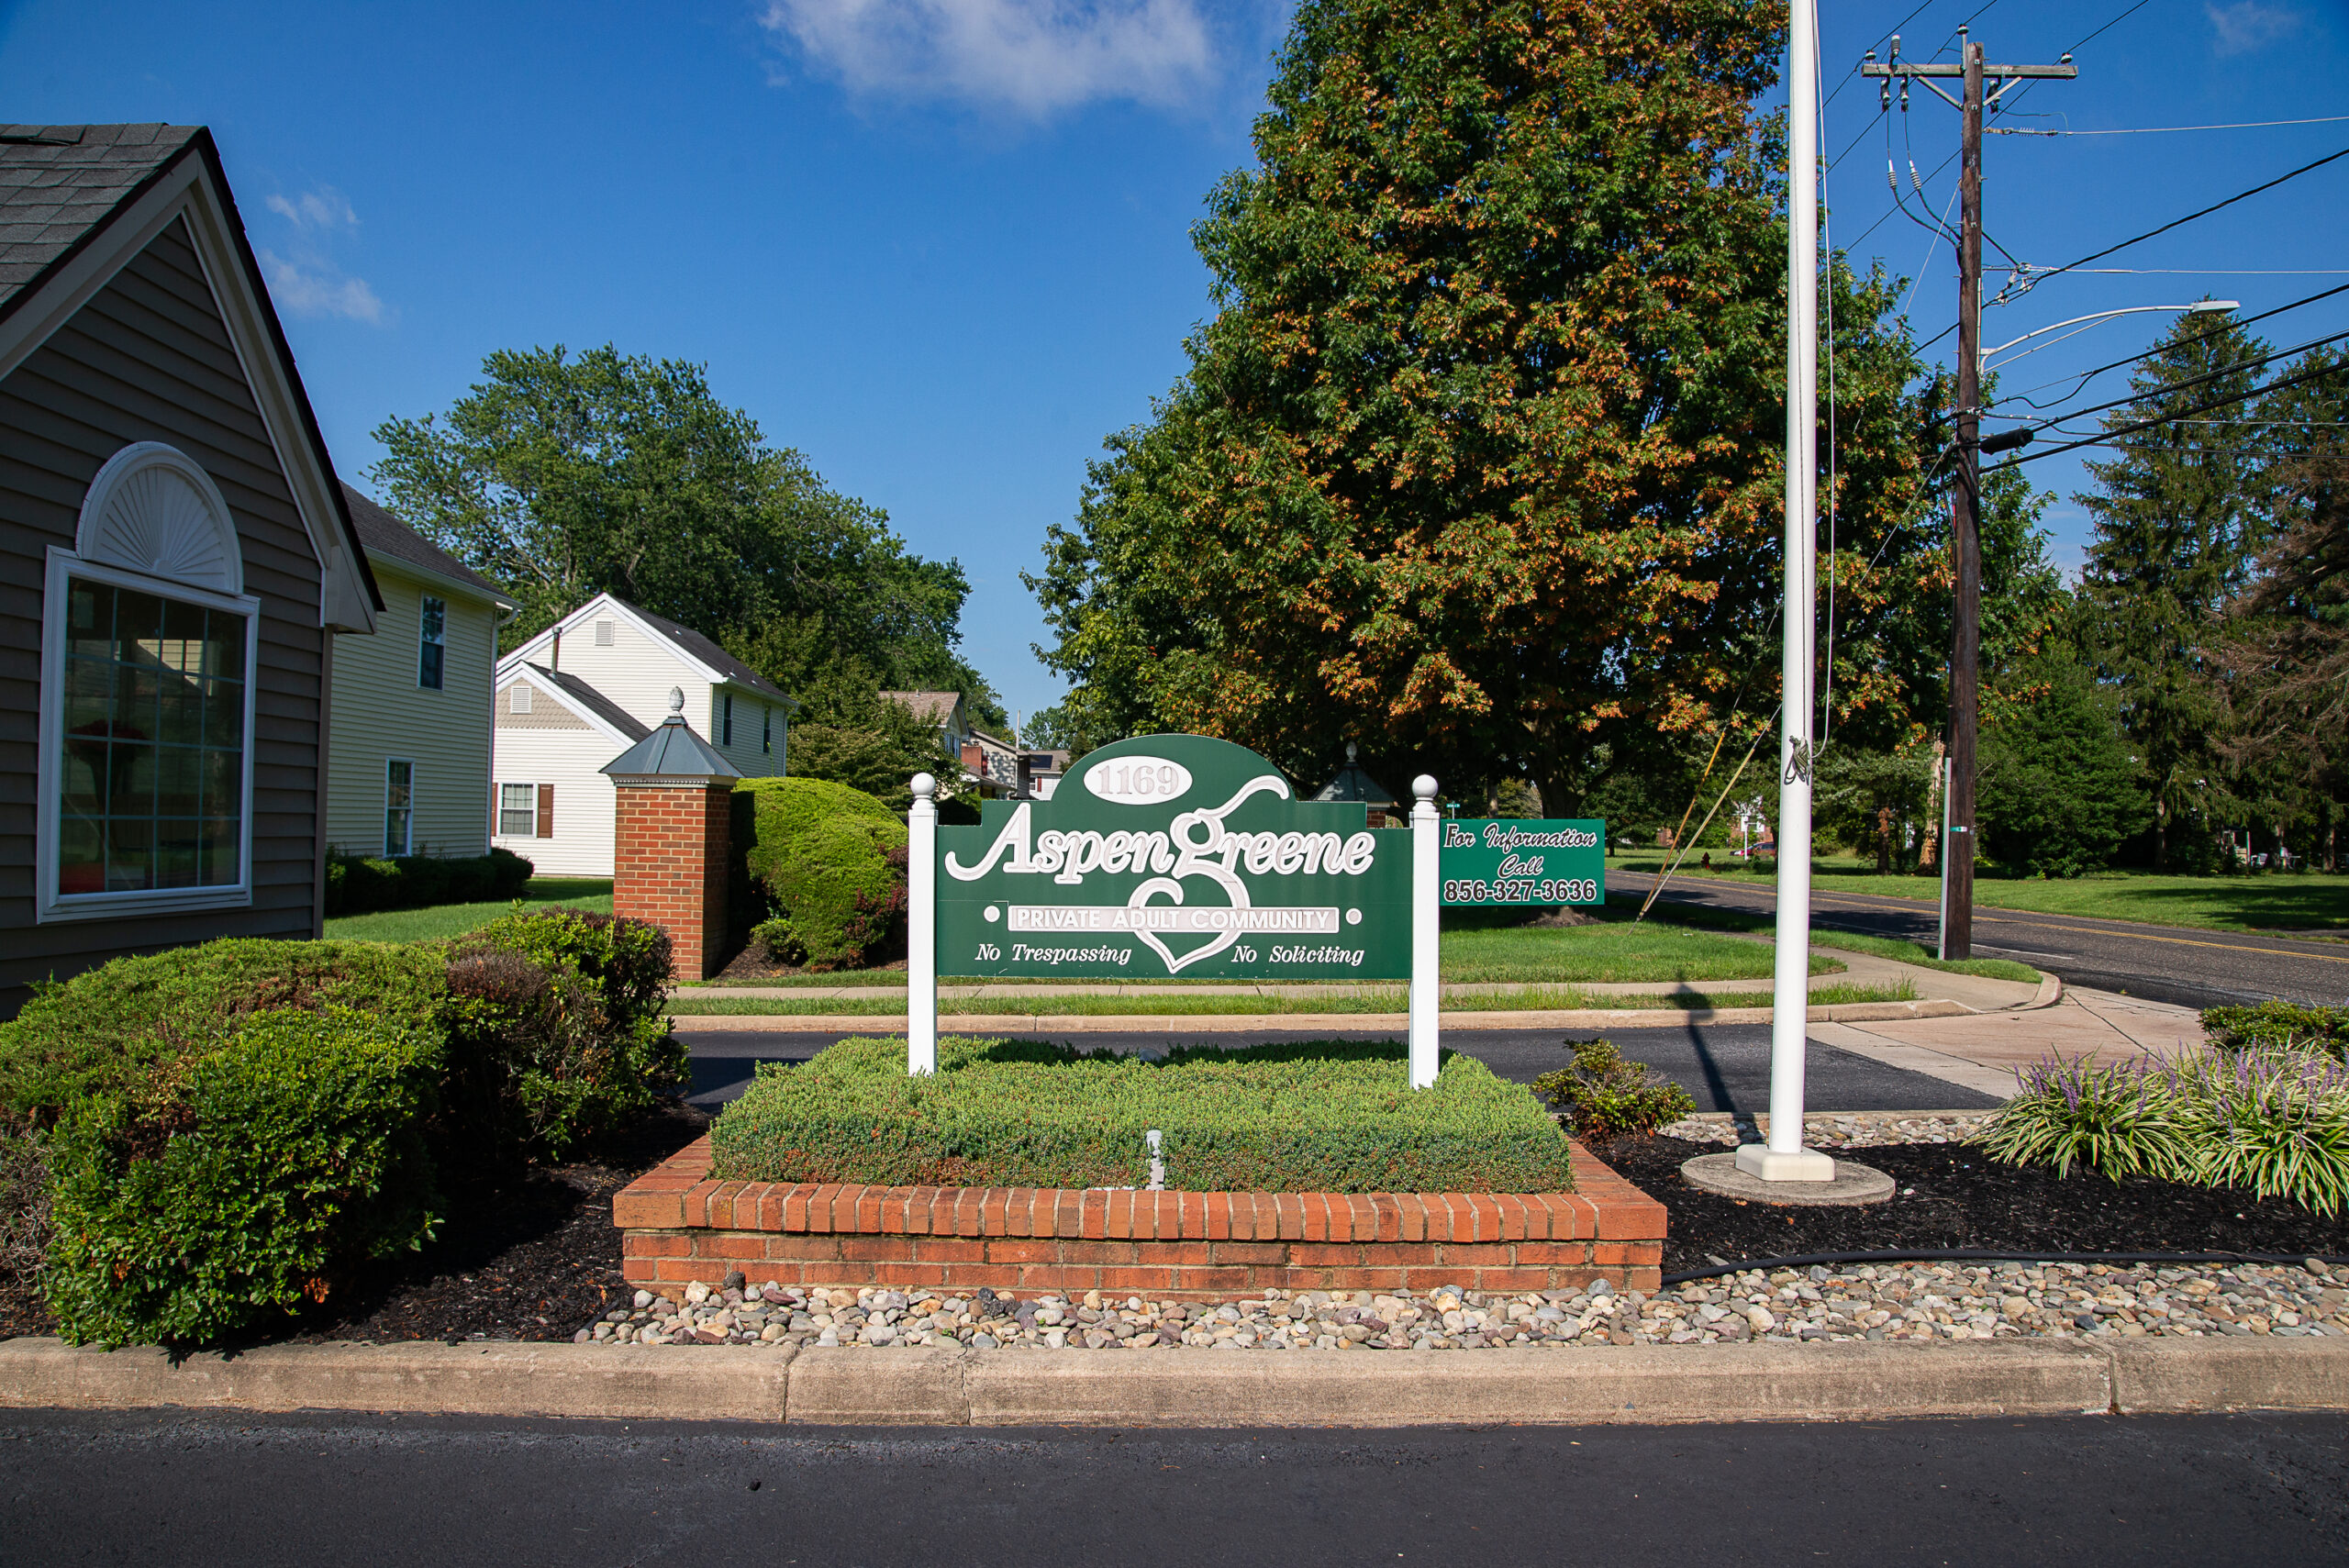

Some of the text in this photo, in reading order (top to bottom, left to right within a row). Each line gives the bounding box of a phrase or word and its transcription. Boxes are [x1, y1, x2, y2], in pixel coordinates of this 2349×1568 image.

[1097, 764, 1179, 795] 1169
[1443, 822, 1598, 854] For Information
[1497, 853, 1544, 879] Call
[1443, 879, 1597, 903] 856-327-3636
[1017, 908, 1330, 930] PRIVATE ADULT COMMUNITY
[974, 943, 1132, 966] No Trespassing
[1230, 945, 1365, 967] No Soliciting
